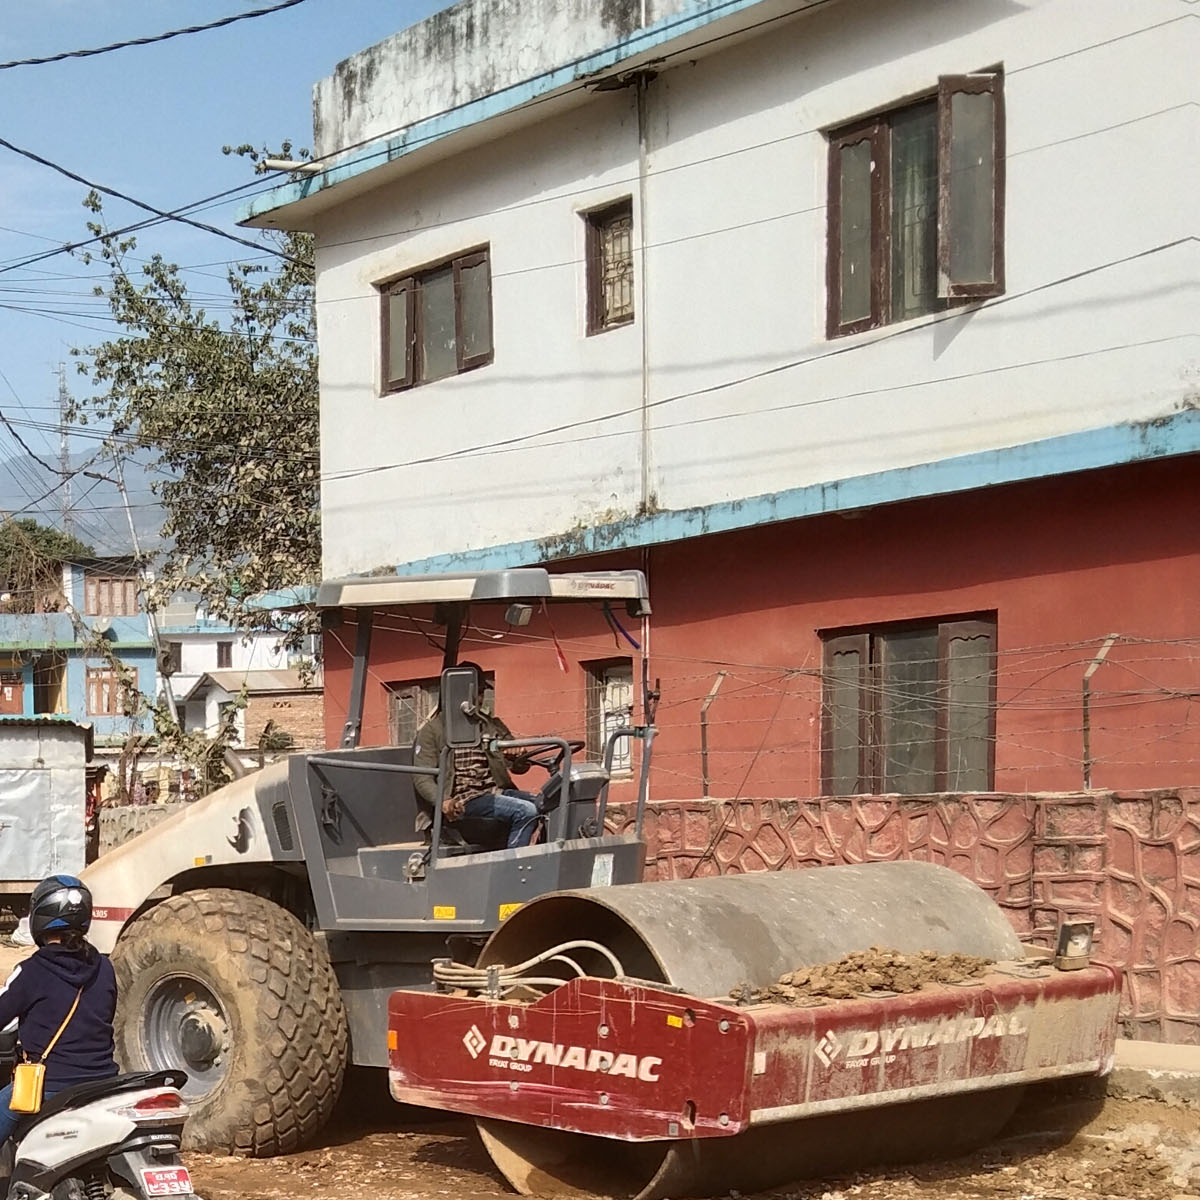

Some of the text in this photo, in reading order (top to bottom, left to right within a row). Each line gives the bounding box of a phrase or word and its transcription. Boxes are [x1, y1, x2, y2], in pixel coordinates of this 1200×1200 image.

[846, 1012, 1029, 1058] DYNAPAC
[489, 1034, 663, 1083] DYNAPAC
[509, 1062, 533, 1073] GROUP
